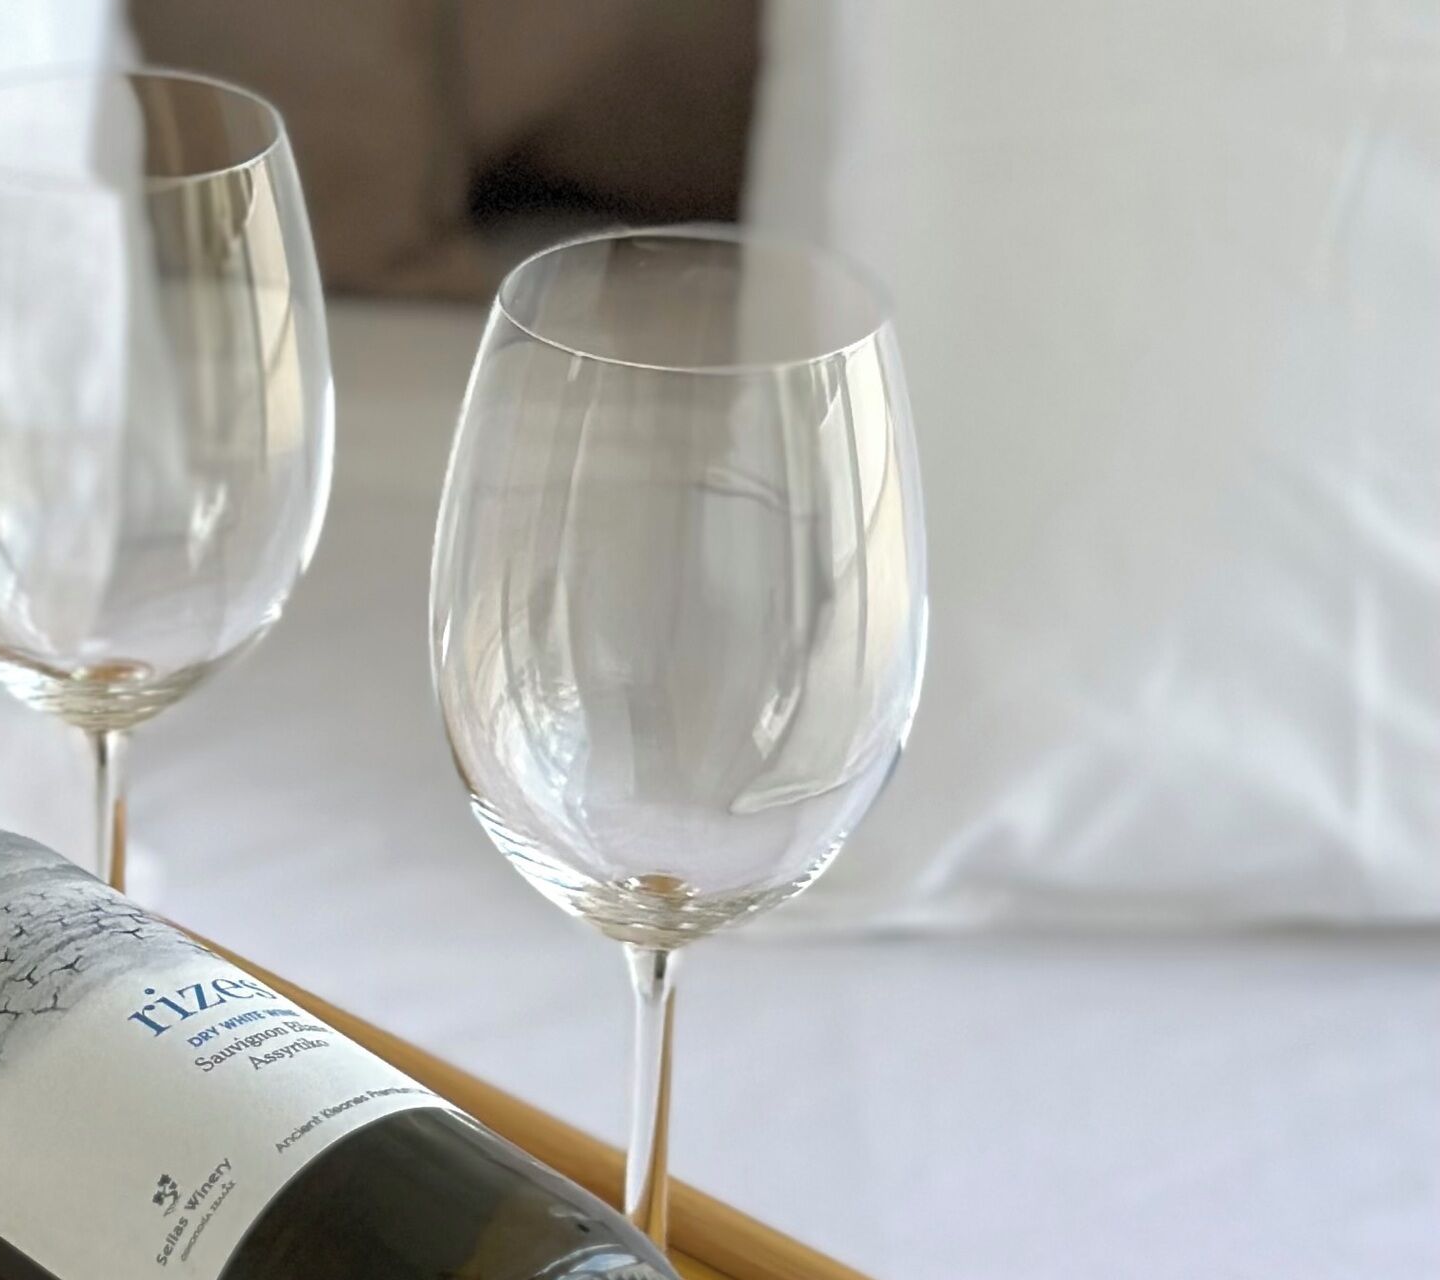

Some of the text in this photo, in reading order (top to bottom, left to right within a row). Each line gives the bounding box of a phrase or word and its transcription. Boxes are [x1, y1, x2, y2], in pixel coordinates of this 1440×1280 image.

[128, 978, 277, 1037] rizes
[187, 1026, 220, 1048] DRY
[219, 1011, 265, 1030] WHITE
[195, 1026, 289, 1072] Sauvignon
[249, 1038, 330, 1071] Assyrtiko
[275, 1115, 322, 1153] Ancient
[156, 1216, 188, 1266] Sellas
[184, 1158, 231, 1210] Winery
